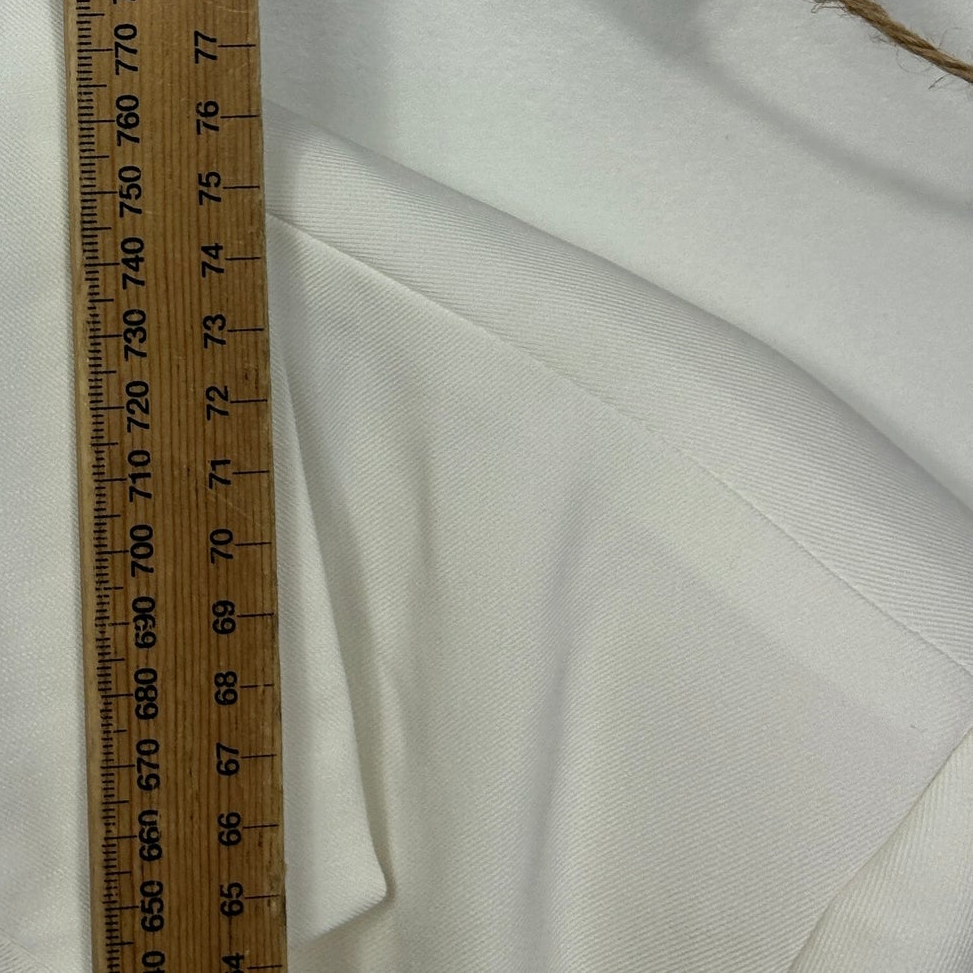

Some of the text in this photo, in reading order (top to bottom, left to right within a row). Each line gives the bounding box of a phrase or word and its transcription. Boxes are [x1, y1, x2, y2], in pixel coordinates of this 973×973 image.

[115, 23, 138, 75] 770
[194, 30, 218, 64] 77
[116, 94, 140, 146] 760
[197, 100, 220, 134] 76
[118, 165, 142, 218] 750
[199, 171, 222, 205] 75
[121, 237, 145, 289] 740
[201, 243, 225, 277] 74
[124, 308, 148, 360] 730
[204, 314, 227, 348] 73
[126, 380, 150, 432] 720
[207, 385, 230, 420] 72
[128, 450, 152, 502] 710
[209, 459, 232, 489] 71
[129, 524, 154, 577] 700
[210, 529, 234, 564] 70
[132, 596, 157, 648] 690
[213, 600, 237, 635] 69
[135, 667, 159, 720] 680
[215, 670, 239, 705] 68
[136, 738, 160, 791] 670
[217, 742, 241, 776] 67
[139, 809, 162, 862] 660
[219, 812, 243, 847] 66
[140, 880, 165, 932] 650
[221, 882, 245, 917] 65
